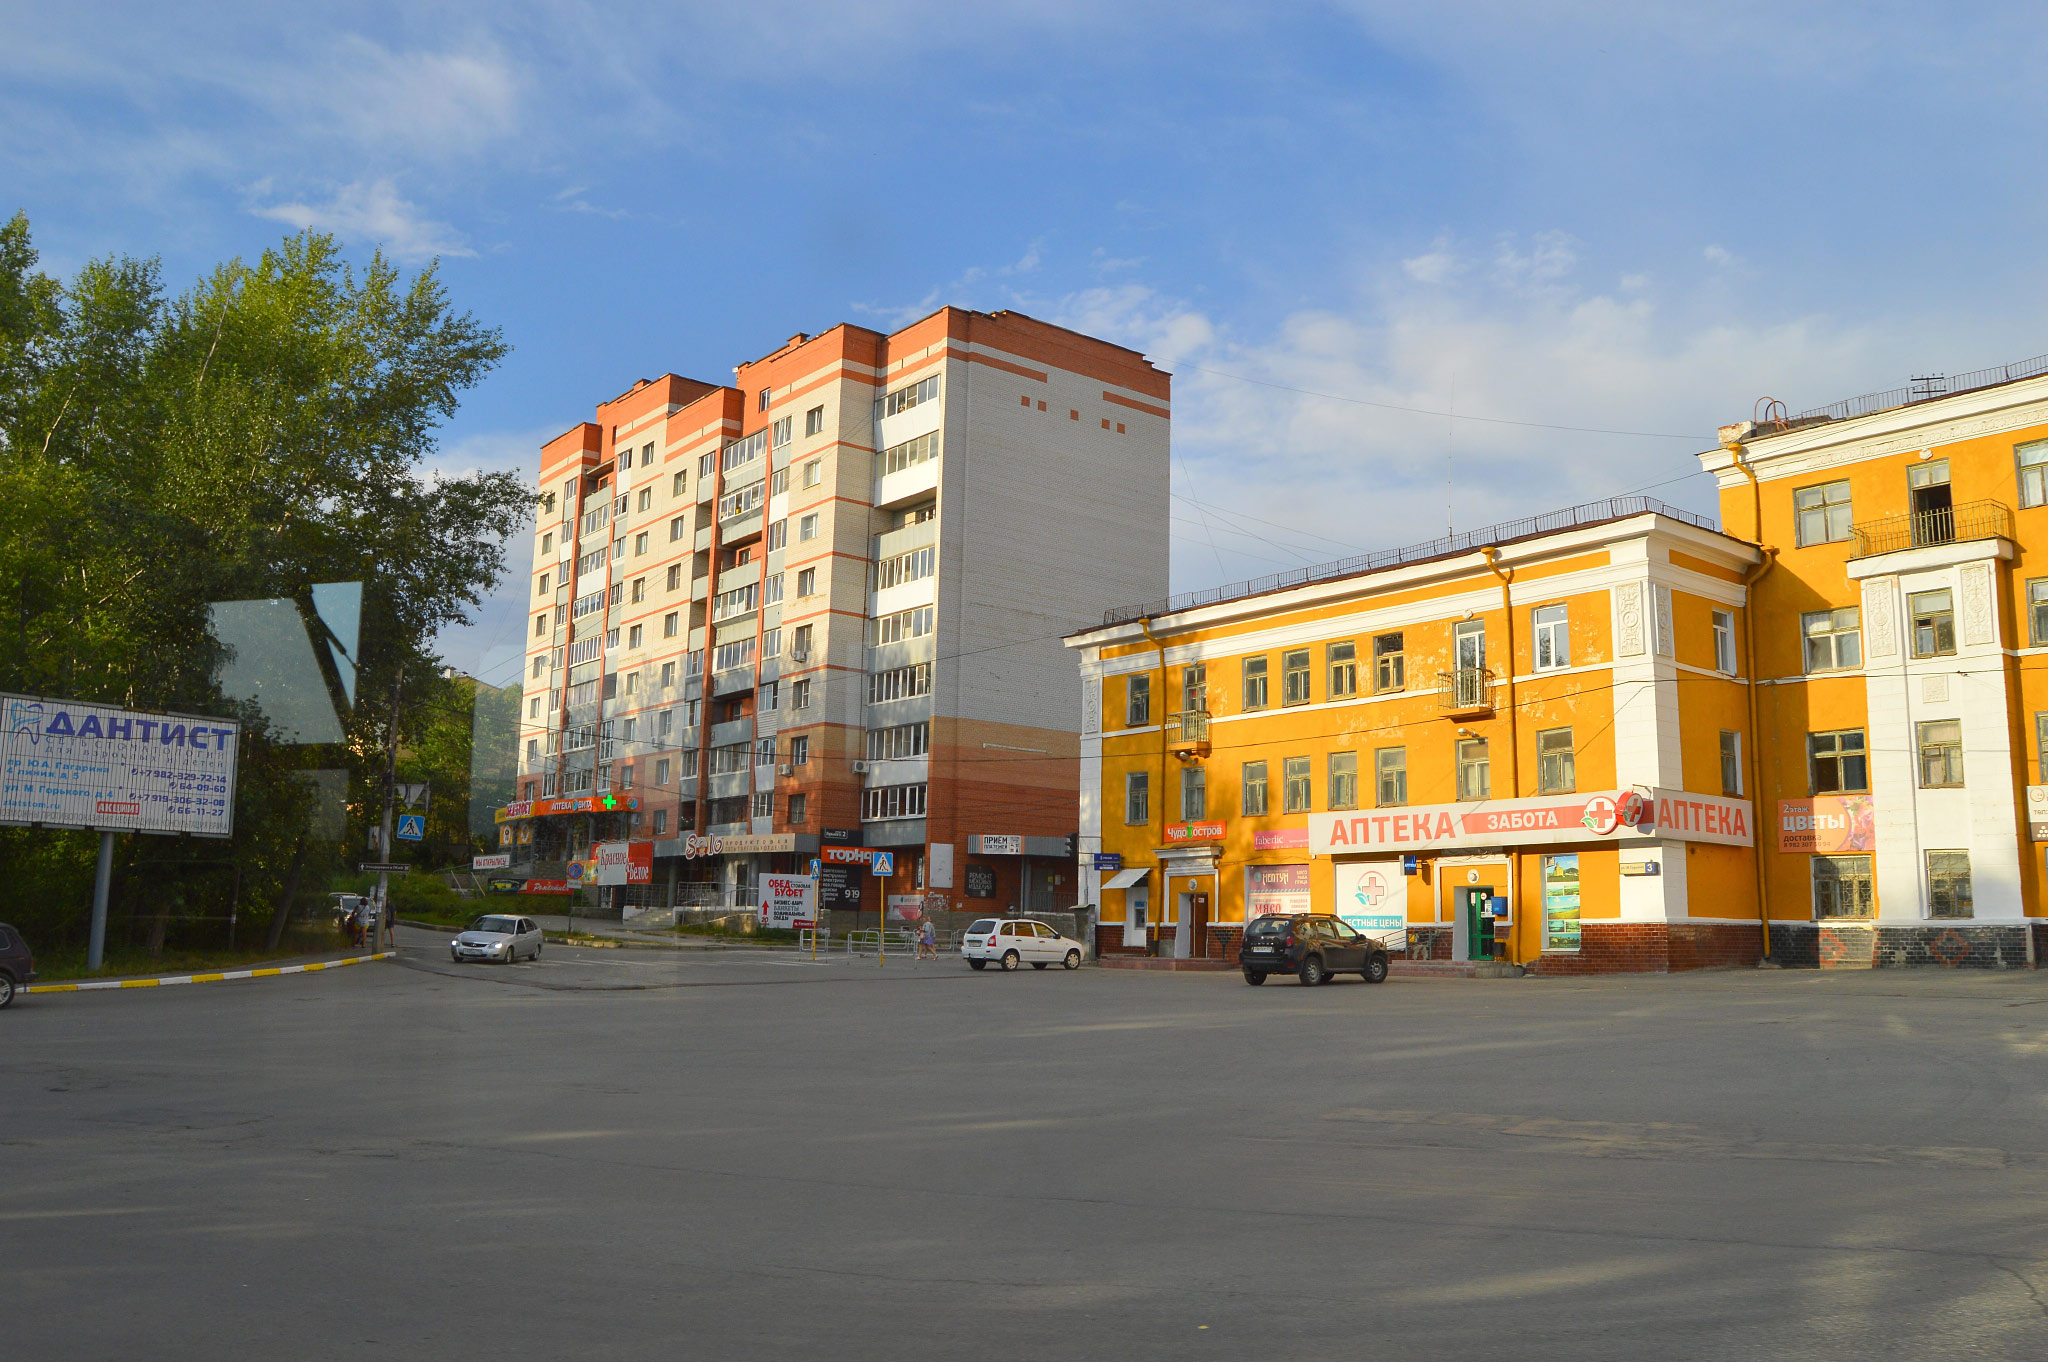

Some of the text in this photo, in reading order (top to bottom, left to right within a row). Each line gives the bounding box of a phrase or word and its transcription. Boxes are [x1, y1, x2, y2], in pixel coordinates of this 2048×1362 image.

[46, 711, 233, 750] ДАНТИСТ
[551, 802, 572, 811] АПТЕКА
[1657, 798, 1747, 838] АПТЕКА
[1783, 814, 1845, 833] ЦВЕТЫ
[1167, 826, 1222, 840] Чудо остров
[1330, 810, 1559, 846] АПТЕКА ЗАБОТА
[1255, 835, 1284, 845] faberlic
[1783, 835, 1822, 843] доставка
[600, 848, 627, 870] Красное
[629, 861, 649, 880] Белое
[1647, 863, 1653, 872] 3
[768, 879, 790, 889] ОБЕД
[1262, 872, 1289, 886] НЕПТУН
[775, 888, 804, 897] БУФЕТ
[1255, 903, 1281, 914] МЯСО
[1343, 918, 1402, 929] ЧЕСТНЫЕ ЦЕНЫ
